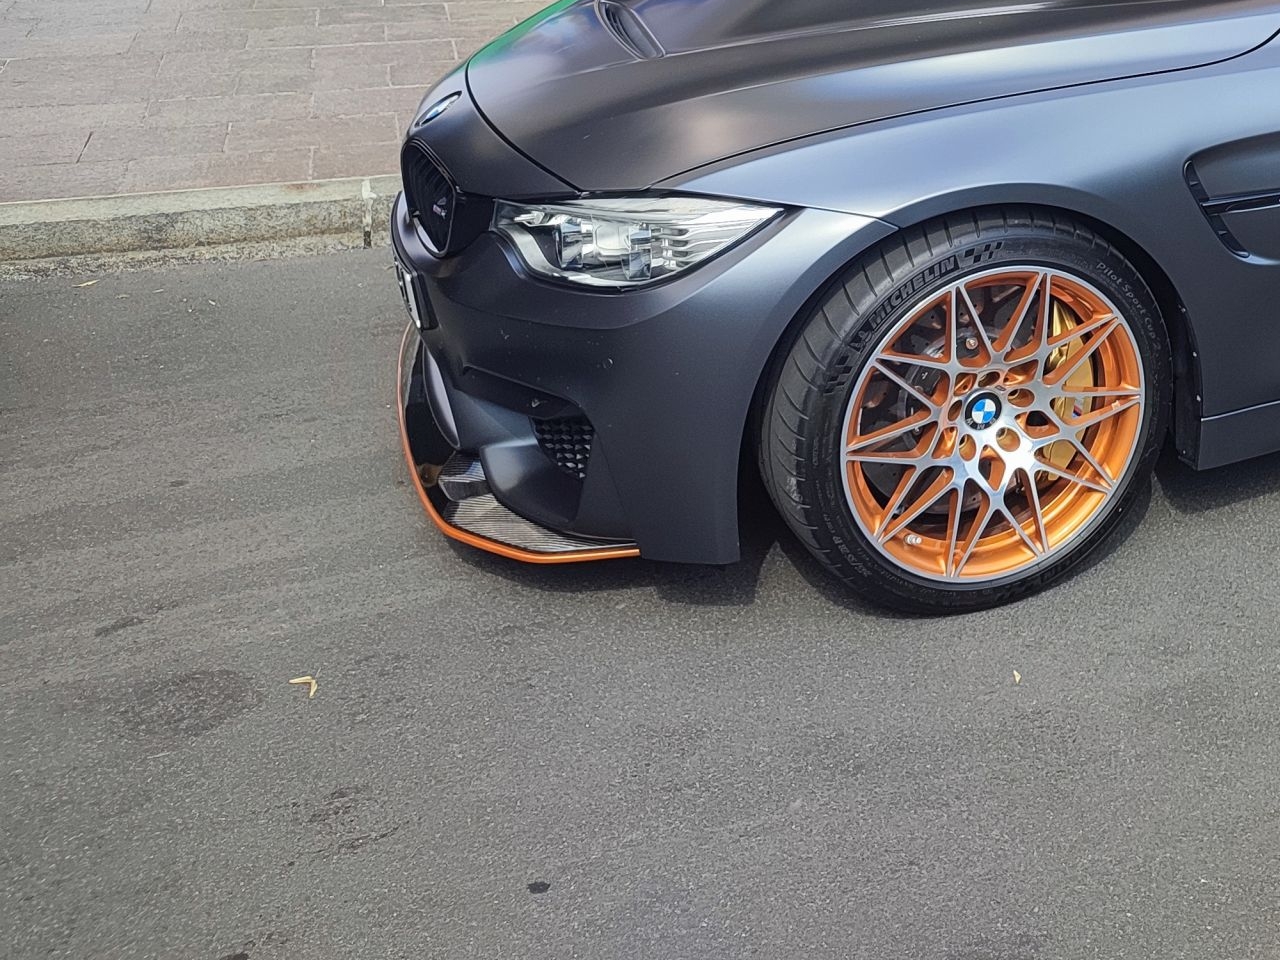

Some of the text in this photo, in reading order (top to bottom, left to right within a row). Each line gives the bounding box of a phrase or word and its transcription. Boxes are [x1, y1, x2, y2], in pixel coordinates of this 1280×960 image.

[868, 254, 958, 331] MICHELIN
[1096, 262, 1123, 285] Pilot
[1122, 282, 1147, 315] Sport
